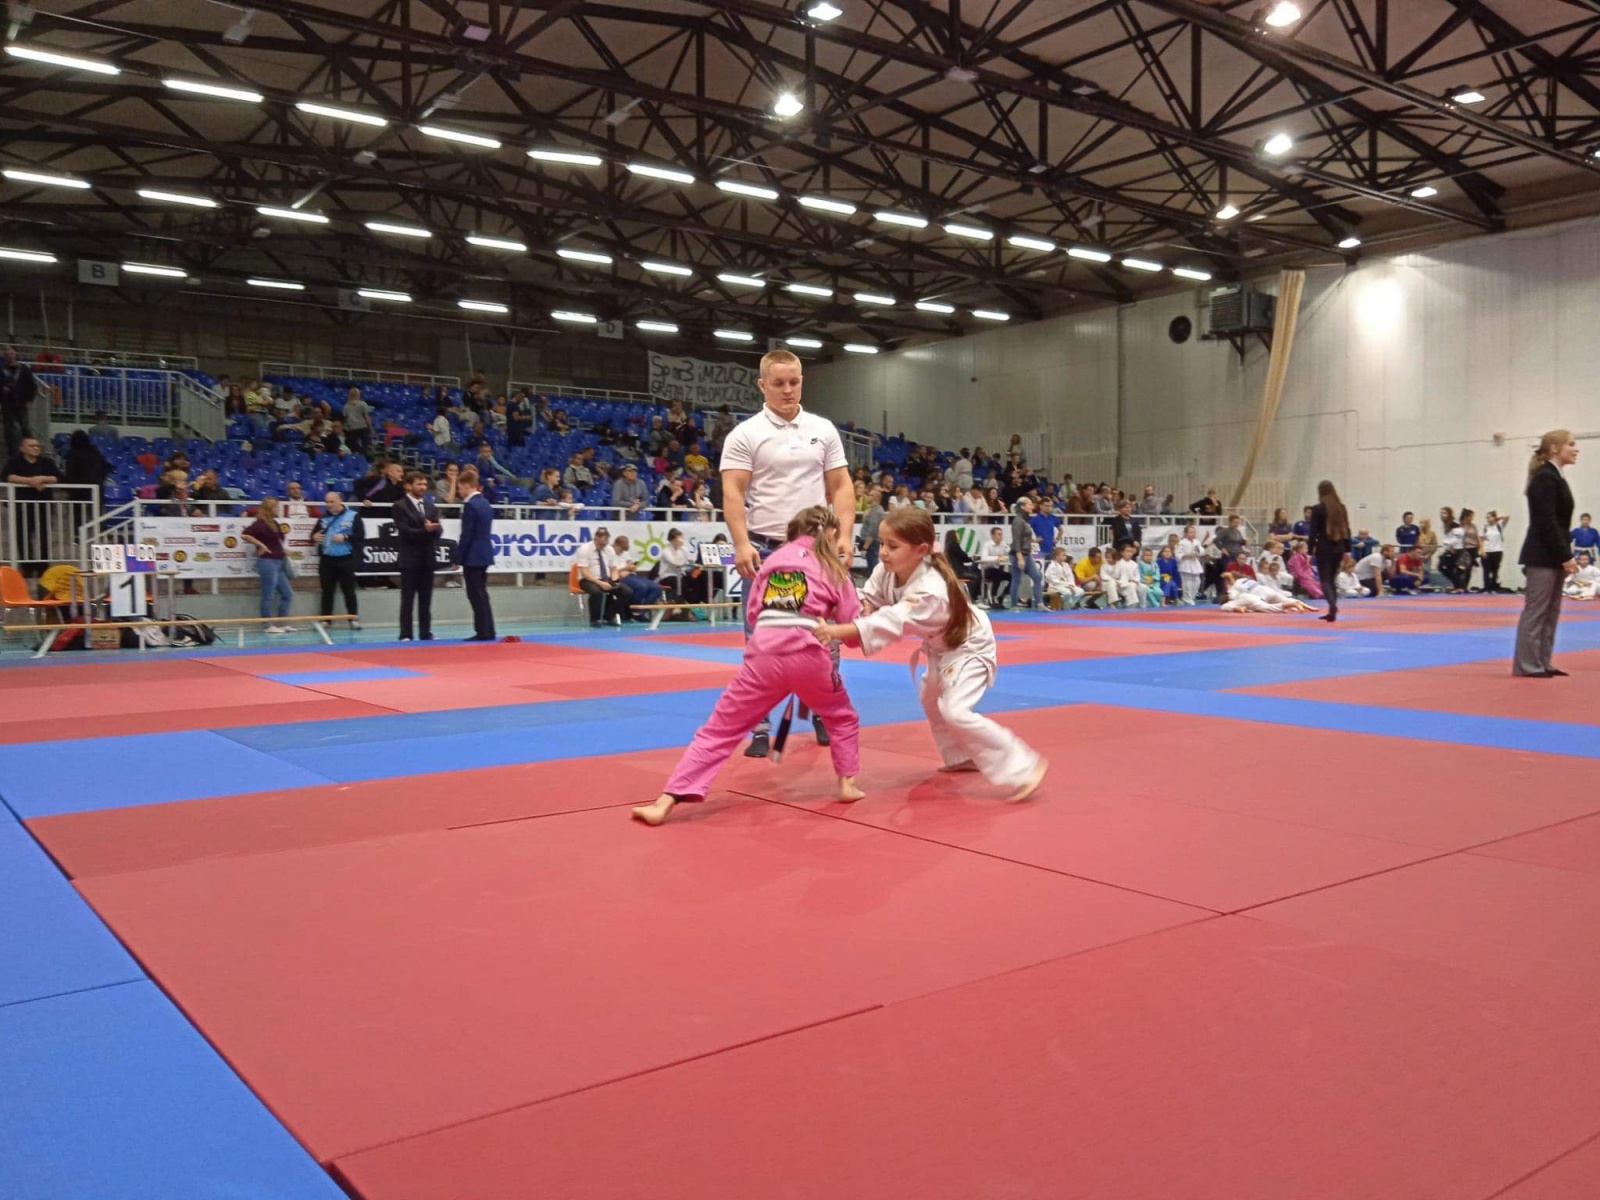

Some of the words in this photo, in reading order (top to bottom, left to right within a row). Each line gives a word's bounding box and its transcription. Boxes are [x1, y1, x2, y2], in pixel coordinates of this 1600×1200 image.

[92, 264, 105, 279] B
[607, 322, 616, 334] D
[119, 575, 137, 614] 1
